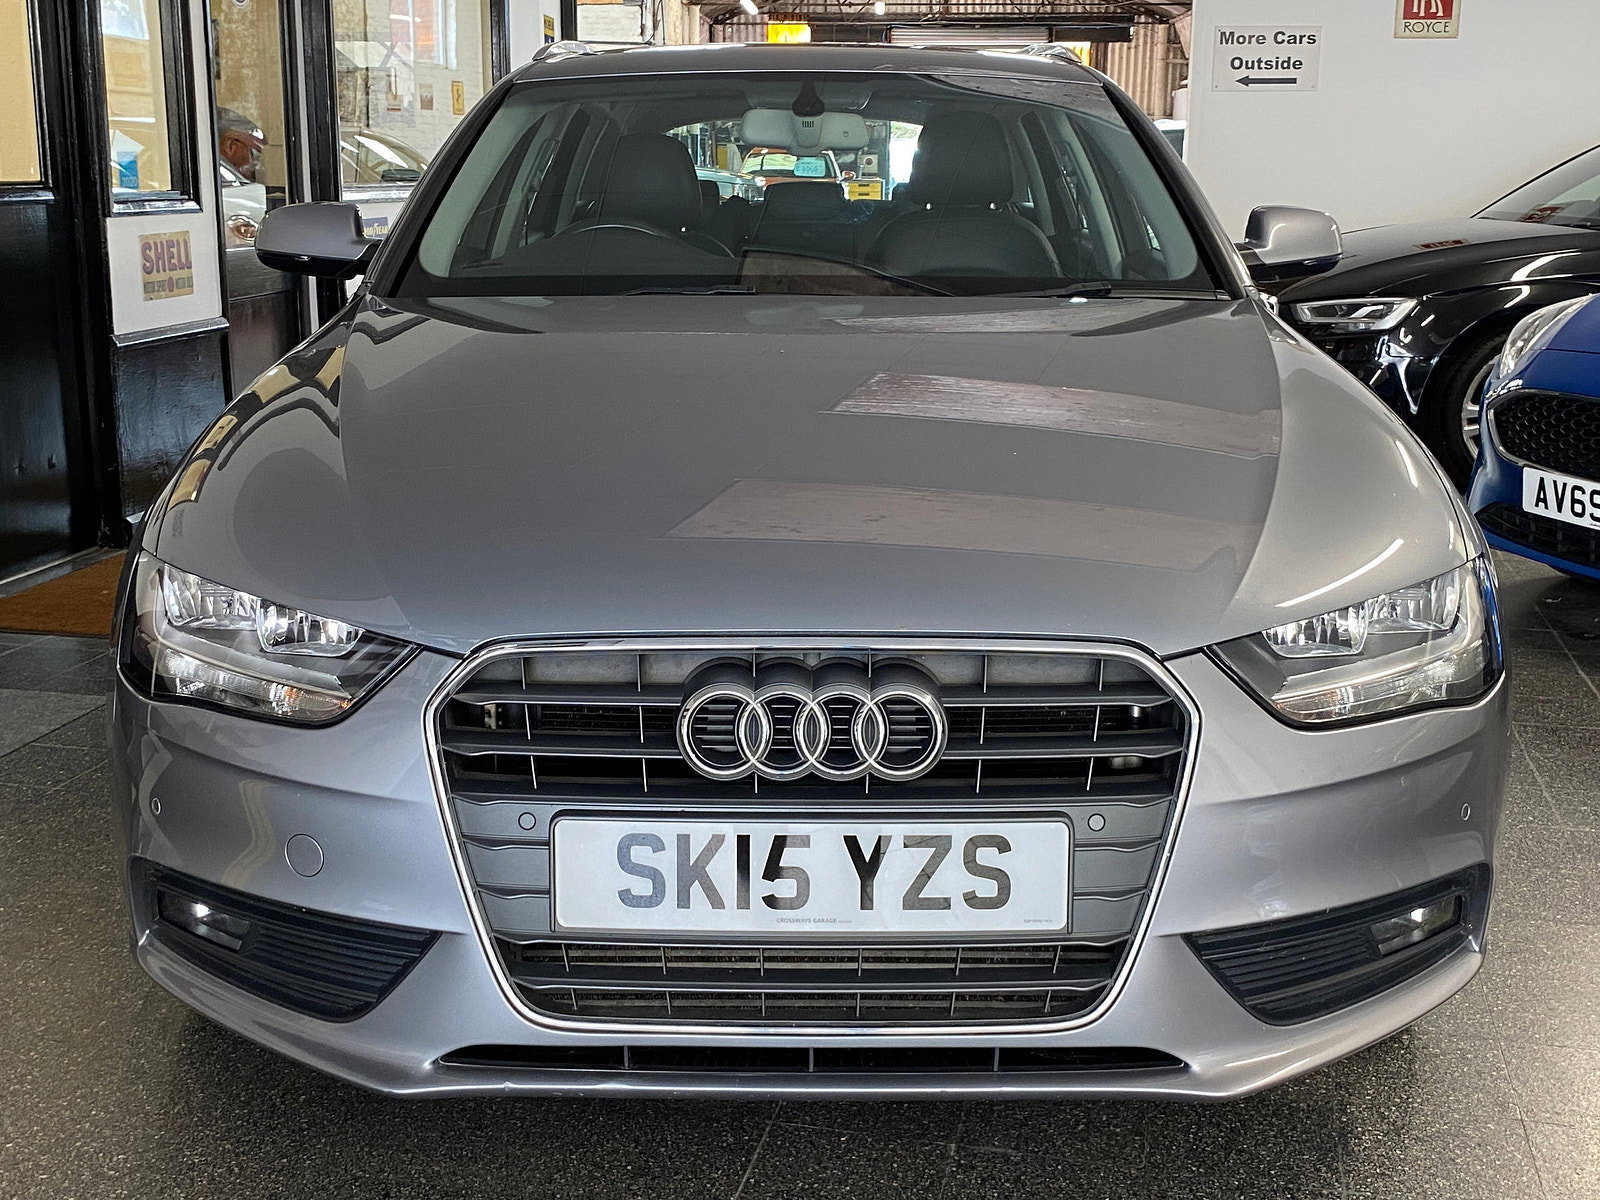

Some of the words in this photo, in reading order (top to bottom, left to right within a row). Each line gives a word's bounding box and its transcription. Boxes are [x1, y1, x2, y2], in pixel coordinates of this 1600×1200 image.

[1403, 21, 1450, 33] ROYCE
[1219, 31, 1267, 45] More
[1273, 30, 1317, 45] Cars
[1229, 56, 1303, 70] Outside
[141, 239, 192, 274] SHELL
[616, 832, 811, 911] SK15
[842, 833, 1012, 911] YZS
